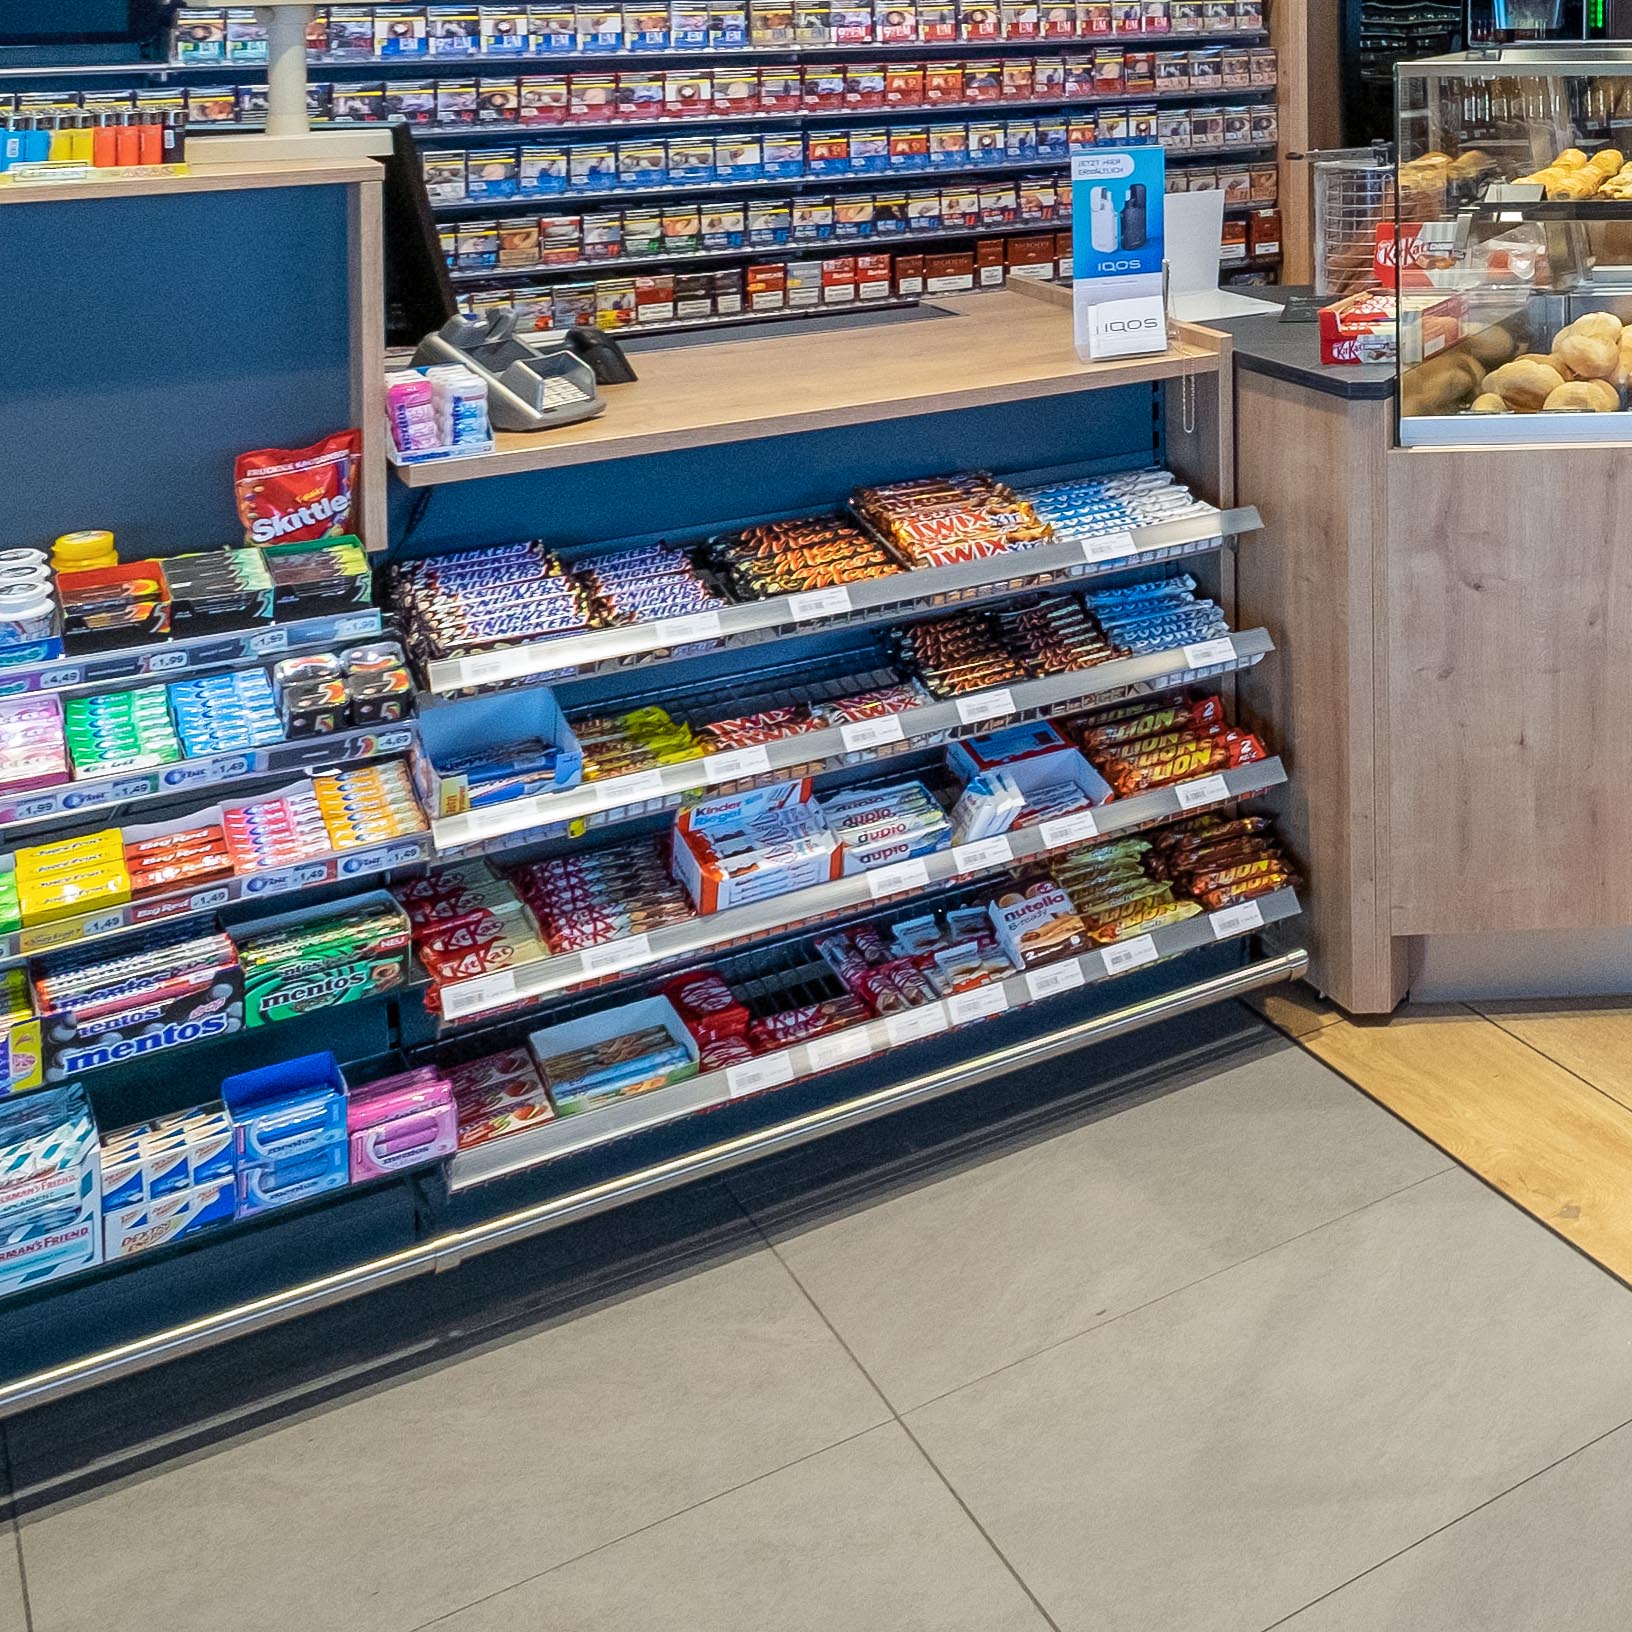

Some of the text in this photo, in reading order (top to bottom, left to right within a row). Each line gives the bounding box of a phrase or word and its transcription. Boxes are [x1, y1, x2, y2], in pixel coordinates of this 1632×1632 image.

[1098, 260, 1141, 272] IQOS
[1104, 318, 1159, 333] IQOS
[907, 511, 990, 541] TWIX
[922, 537, 1007, 567] TWIX
[1116, 710, 1176, 738] LION
[1241, 739, 1253, 755] 2
[1153, 749, 1212, 781] LION
[696, 800, 741, 817] Kinder
[139, 830, 209, 851] Big Red
[142, 846, 212, 865] Big Red
[162, 900, 189, 913] Red
[1004, 894, 1065, 922] nutella
[381, 937, 404, 947] NEU
[441, 946, 514, 977] KitKat
[261, 970, 367, 1010] mentos
[65, 1015, 227, 1073] mentos
[42, 1175, 77, 1192] FRIEND
[44, 1227, 89, 1248] FRIEND
